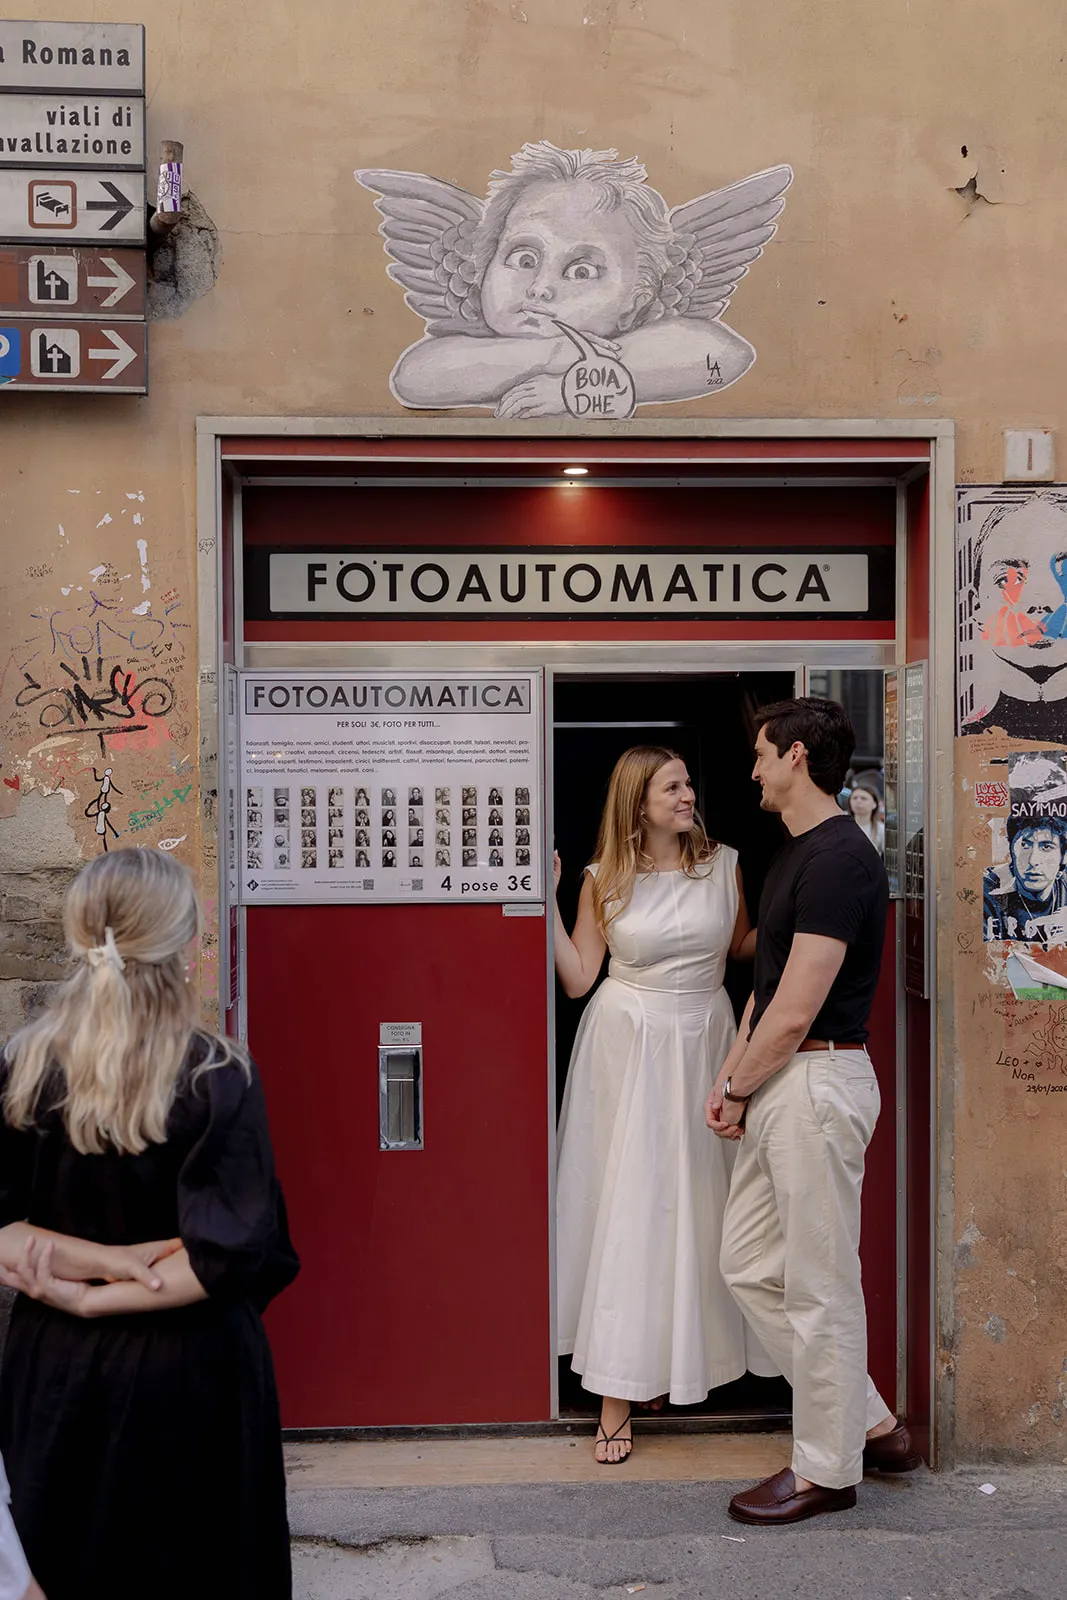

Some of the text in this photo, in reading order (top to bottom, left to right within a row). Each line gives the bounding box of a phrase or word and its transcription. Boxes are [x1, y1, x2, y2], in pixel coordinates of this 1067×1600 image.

[22, 39, 131, 66] Romana
[46, 105, 132, 127] viali di
[575, 366, 621, 391] BOIA
[1011, 801, 1067, 818] SAY MAO
[440, 875, 532, 894] 4 pose 3€
[996, 1051, 1019, 1067] LEO
[1011, 1068, 1035, 1081] NOA
